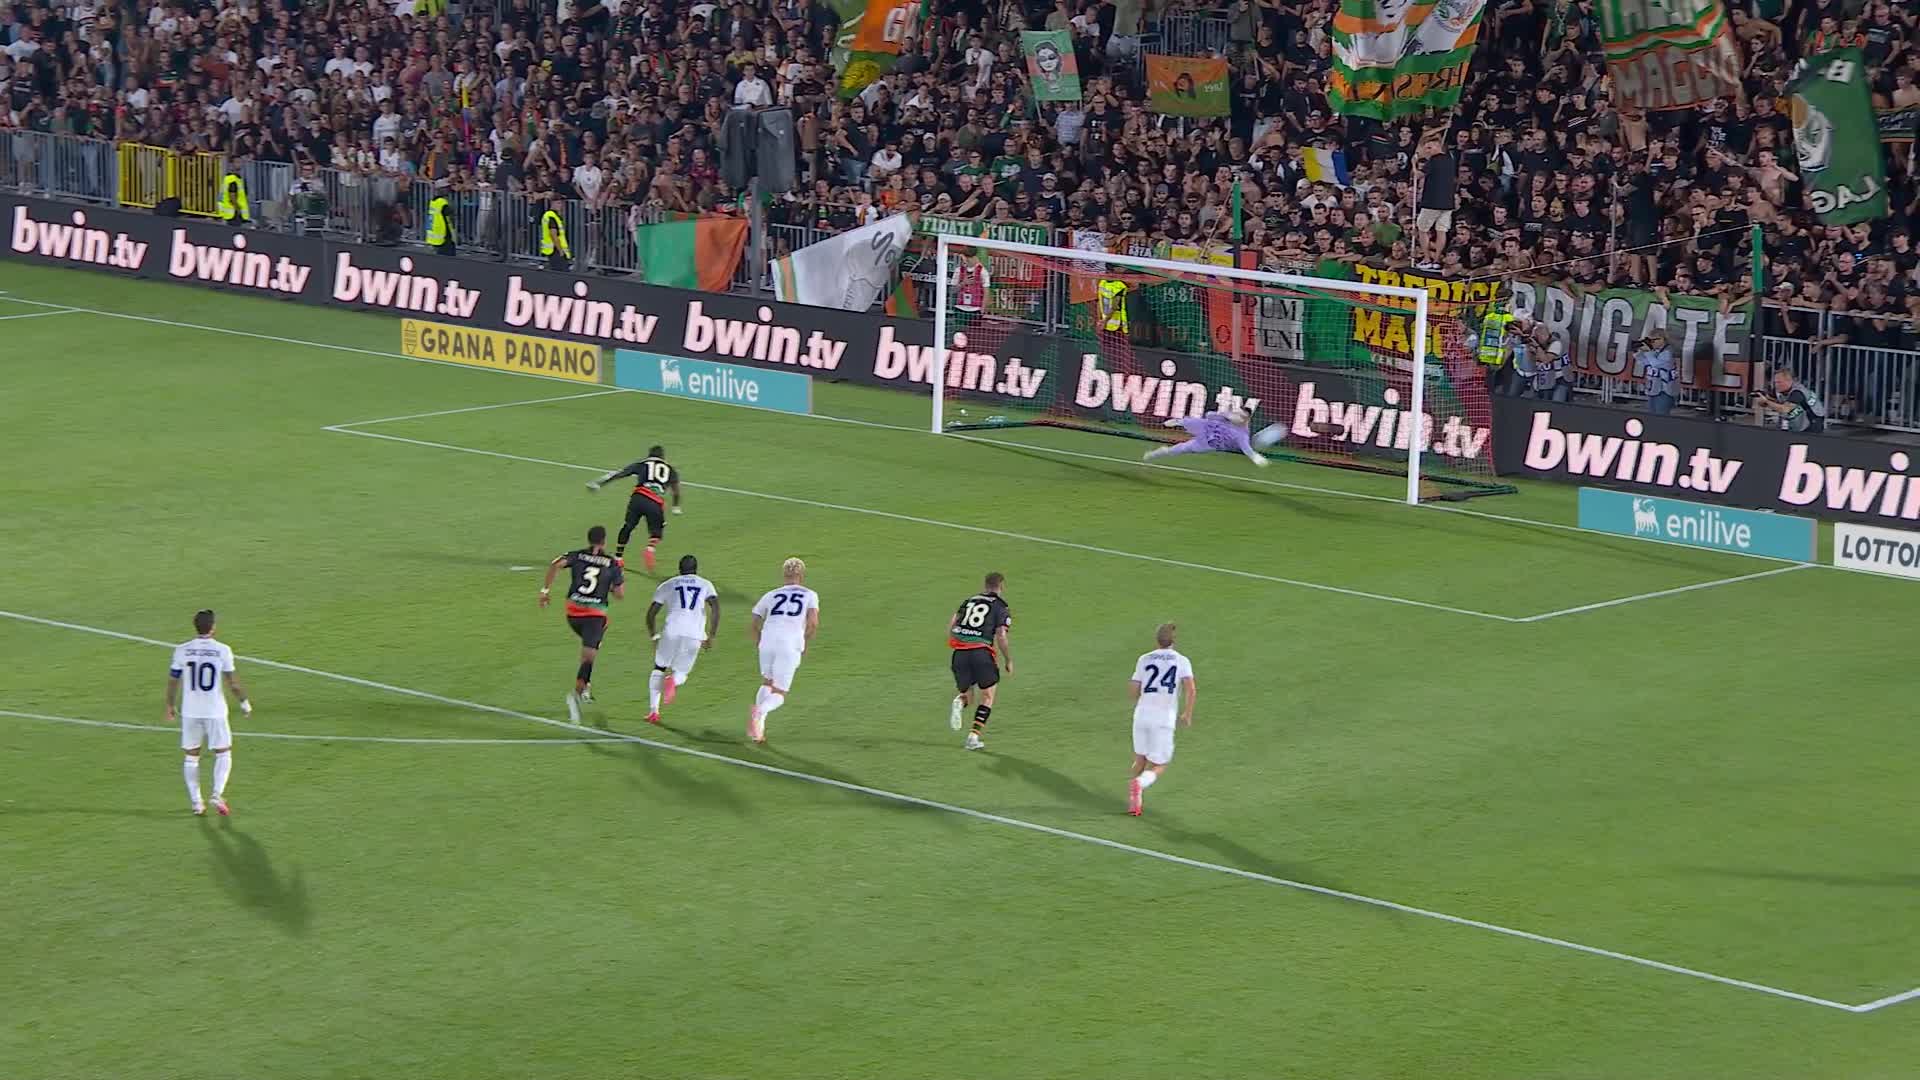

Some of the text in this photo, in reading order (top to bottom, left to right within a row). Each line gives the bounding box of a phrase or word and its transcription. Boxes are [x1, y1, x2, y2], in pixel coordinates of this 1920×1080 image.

[11, 206, 148, 269] bwin.tv
[168, 229, 312, 293] bwin.tv
[333, 252, 480, 318] bwin.tv
[504, 276, 658, 343] bwin.tv
[420, 327, 596, 377] GRANA PADANO
[683, 300, 848, 371] bwin.tv
[688, 368, 760, 402] enilive
[873, 326, 1048, 398] bwin.tv
[1074, 354, 1261, 420] bwintv
[1291, 381, 1492, 459] bwin.tv
[645, 461, 670, 483] 10
[1524, 411, 1743, 494] bwin.tv
[1665, 509, 1752, 548] enilive
[577, 566, 600, 595] 3
[675, 586, 701, 611] 17
[770, 593, 804, 617] 25
[961, 602, 990, 628] 18
[186, 661, 216, 692] 10
[1144, 664, 1177, 694] 24
